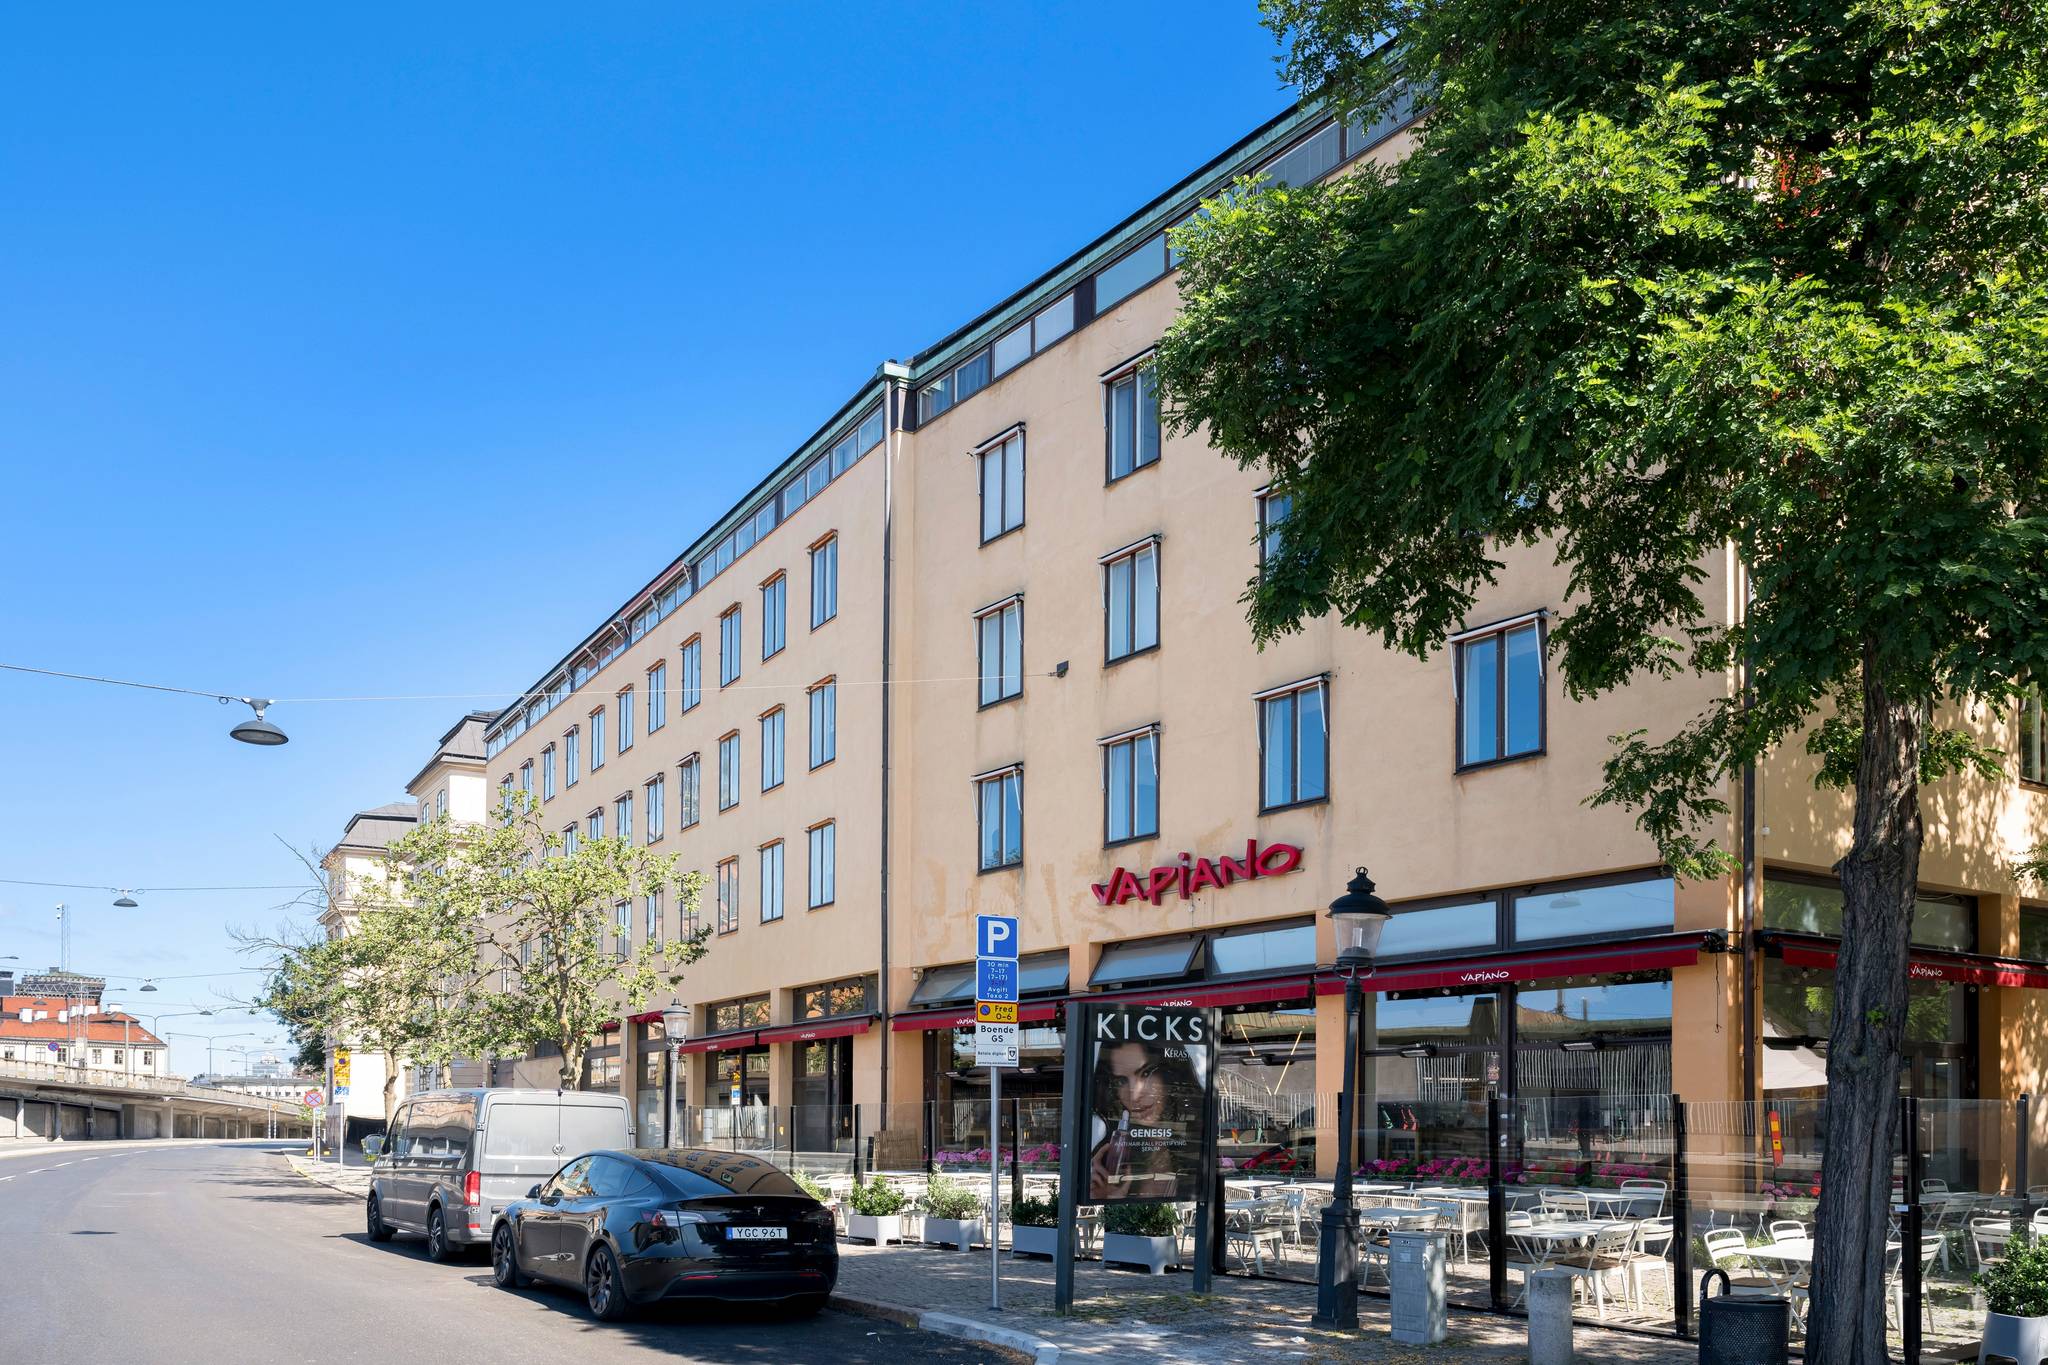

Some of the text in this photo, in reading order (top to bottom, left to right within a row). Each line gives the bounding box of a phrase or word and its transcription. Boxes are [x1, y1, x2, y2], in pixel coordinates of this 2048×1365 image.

[987, 920, 1010, 953] P
[994, 1005, 1012, 1013] Fred
[980, 1025, 1014, 1034] Boende
[1097, 1013, 1203, 1042] KICKS
[991, 1034, 1004, 1043] GS
[1130, 1129, 1172, 1138] GENESIS
[736, 1228, 782, 1238] YGC 96T
